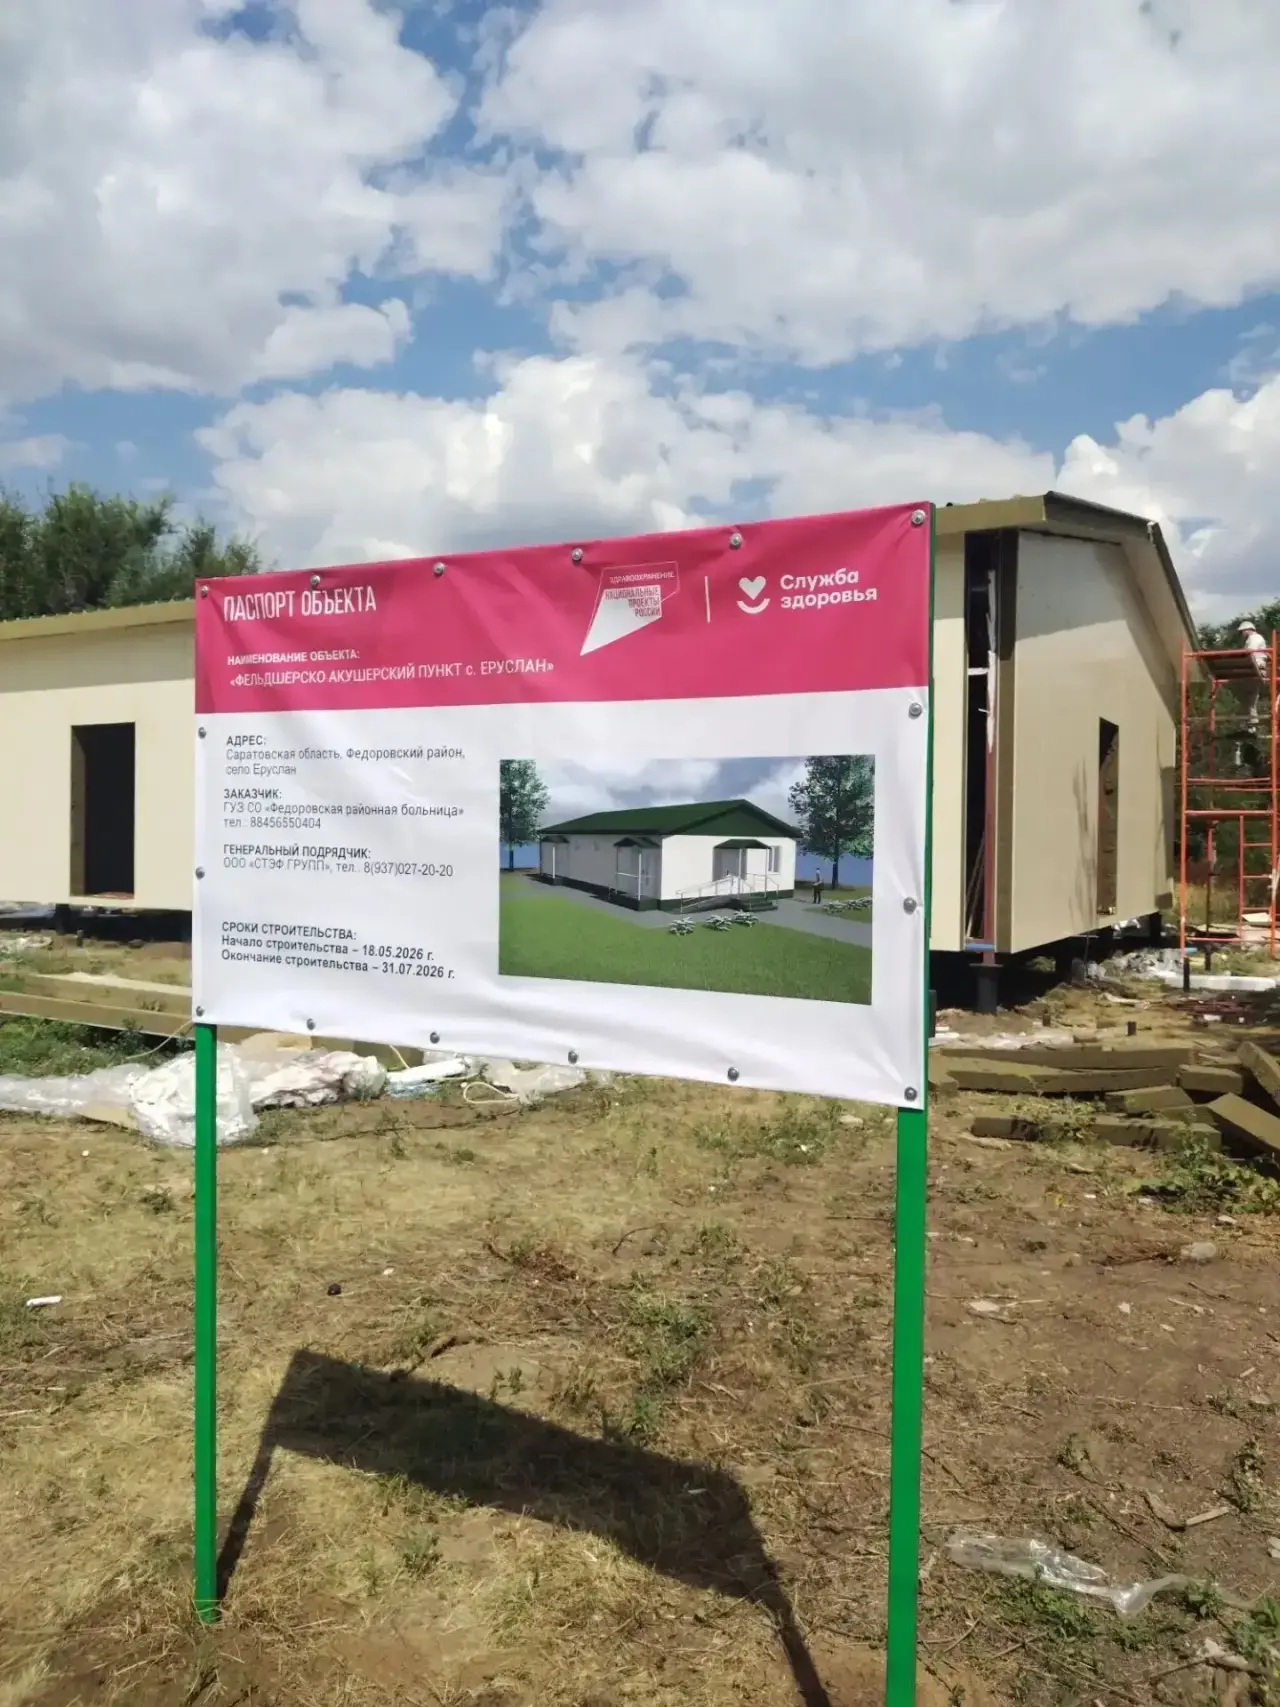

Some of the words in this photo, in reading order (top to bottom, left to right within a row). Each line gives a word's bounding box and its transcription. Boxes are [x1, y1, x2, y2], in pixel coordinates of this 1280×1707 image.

[609, 571, 676, 584] ЗДРАВООХРАНЕНИЕ
[780, 567, 859, 591] Служба
[605, 586, 660, 600] НАЦИОНАЛЬНЫЕ
[780, 587, 878, 611] здоровья
[223, 590, 295, 622] ПАСПОРТ
[301, 586, 377, 618] ОБЪЕКТА
[628, 597, 660, 609] ПРОЕКТЫ
[634, 607, 661, 618] РОССИИ
[227, 651, 308, 666] НАИМЕНОВАНИЕ
[310, 649, 360, 662] ОБЪЕКТА:
[229, 670, 326, 688] «ФЕЛЬДШЕРСКО
[328, 664, 416, 683] АКУШЕРСКИЙ
[418, 662, 462, 679] ПУНКТ
[480, 658, 554, 676] ЕРУСЛАН»
[226, 735, 267, 747] АДРЕС:
[226, 748, 296, 763] Саратовская
[298, 747, 343, 761] область,
[346, 745, 424, 761] Федоровский
[426, 745, 466, 761] район,
[226, 765, 251, 776] село
[253, 764, 297, 778] Еруслан
[223, 788, 283, 800] ЗАКАЗЧИК:
[223, 802, 245, 814] ГУЗ
[247, 802, 263, 814] СО
[265, 802, 343, 817] «Федоровская
[345, 804, 398, 817] районная
[401, 803, 465, 819] больница»
[250, 816, 321, 830] 88456550404
[223, 843, 300, 857] ГЕНЕРАЛЬНЫЙ
[302, 846, 371, 860] ПОДРЯДЧИК:
[223, 857, 246, 869] ООО
[363, 861, 454, 877] 8(937)027-20-20
[221, 921, 259, 934] СРОКИ
[261, 923, 357, 941] СТРОИТЕЛЬСТВА:
[221, 935, 263, 949] Начало
[265, 939, 349, 955] строительства
[362, 944, 424, 960] 18.05.2026
[427, 950, 435, 961] г.
[221, 949, 282, 964] Окончание
[284, 956, 369, 973] строительства
[382, 962, 444, 979] 31.07.2026
[447, 968, 456, 979] г.
